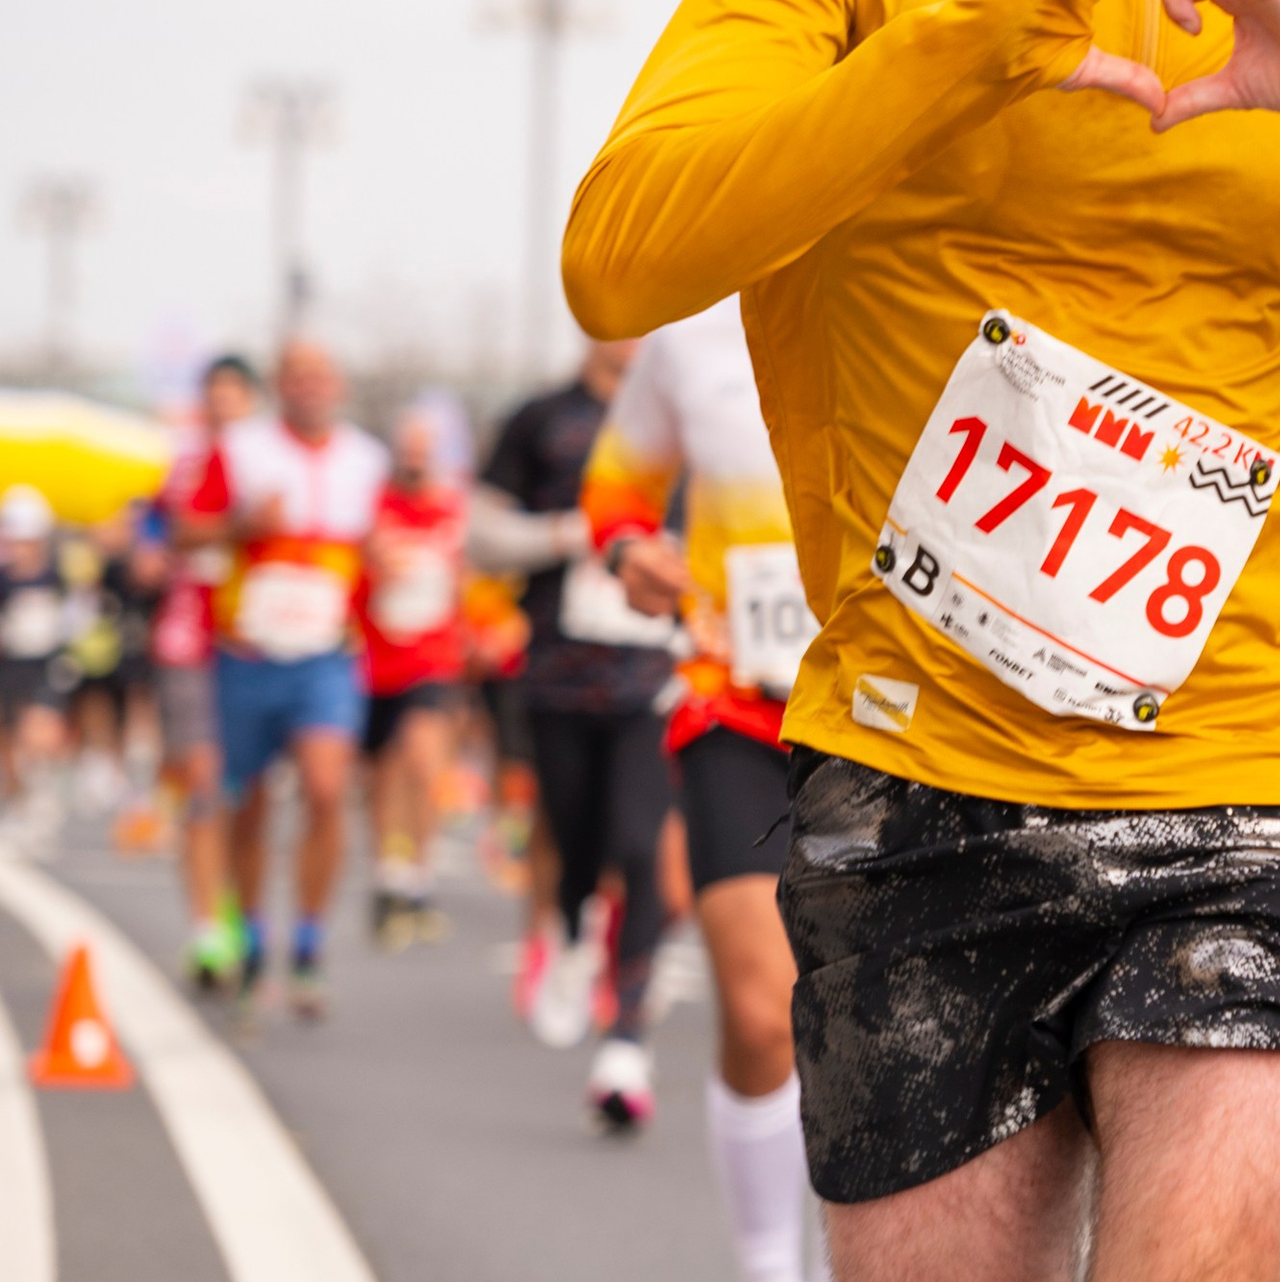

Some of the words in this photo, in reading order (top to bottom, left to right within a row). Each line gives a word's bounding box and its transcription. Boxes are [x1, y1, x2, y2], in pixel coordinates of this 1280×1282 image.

[1173, 415, 1233, 460] 42,2
[935, 415, 1221, 638] 17178
[901, 544, 941, 597] B
